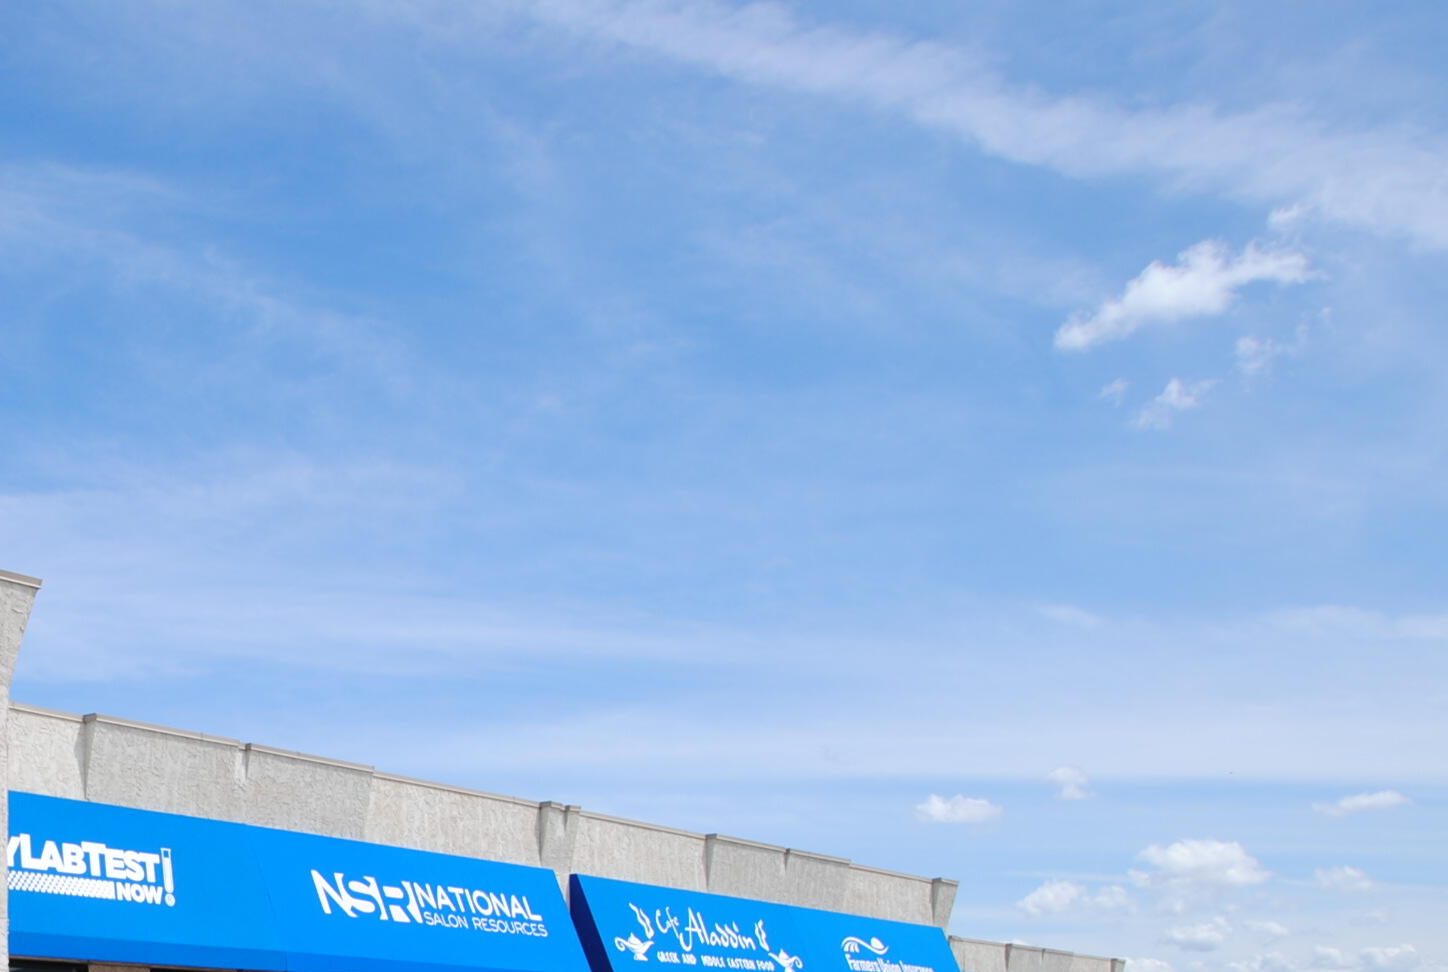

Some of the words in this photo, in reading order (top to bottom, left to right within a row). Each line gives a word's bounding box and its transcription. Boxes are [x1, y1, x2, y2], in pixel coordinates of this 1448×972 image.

[310, 869, 424, 924] NSR
[413, 882, 543, 922] NATIONAL
[423, 911, 469, 929] SALON
[472, 917, 549, 937] RESOURCES
[679, 907, 756, 952] Aladdin
